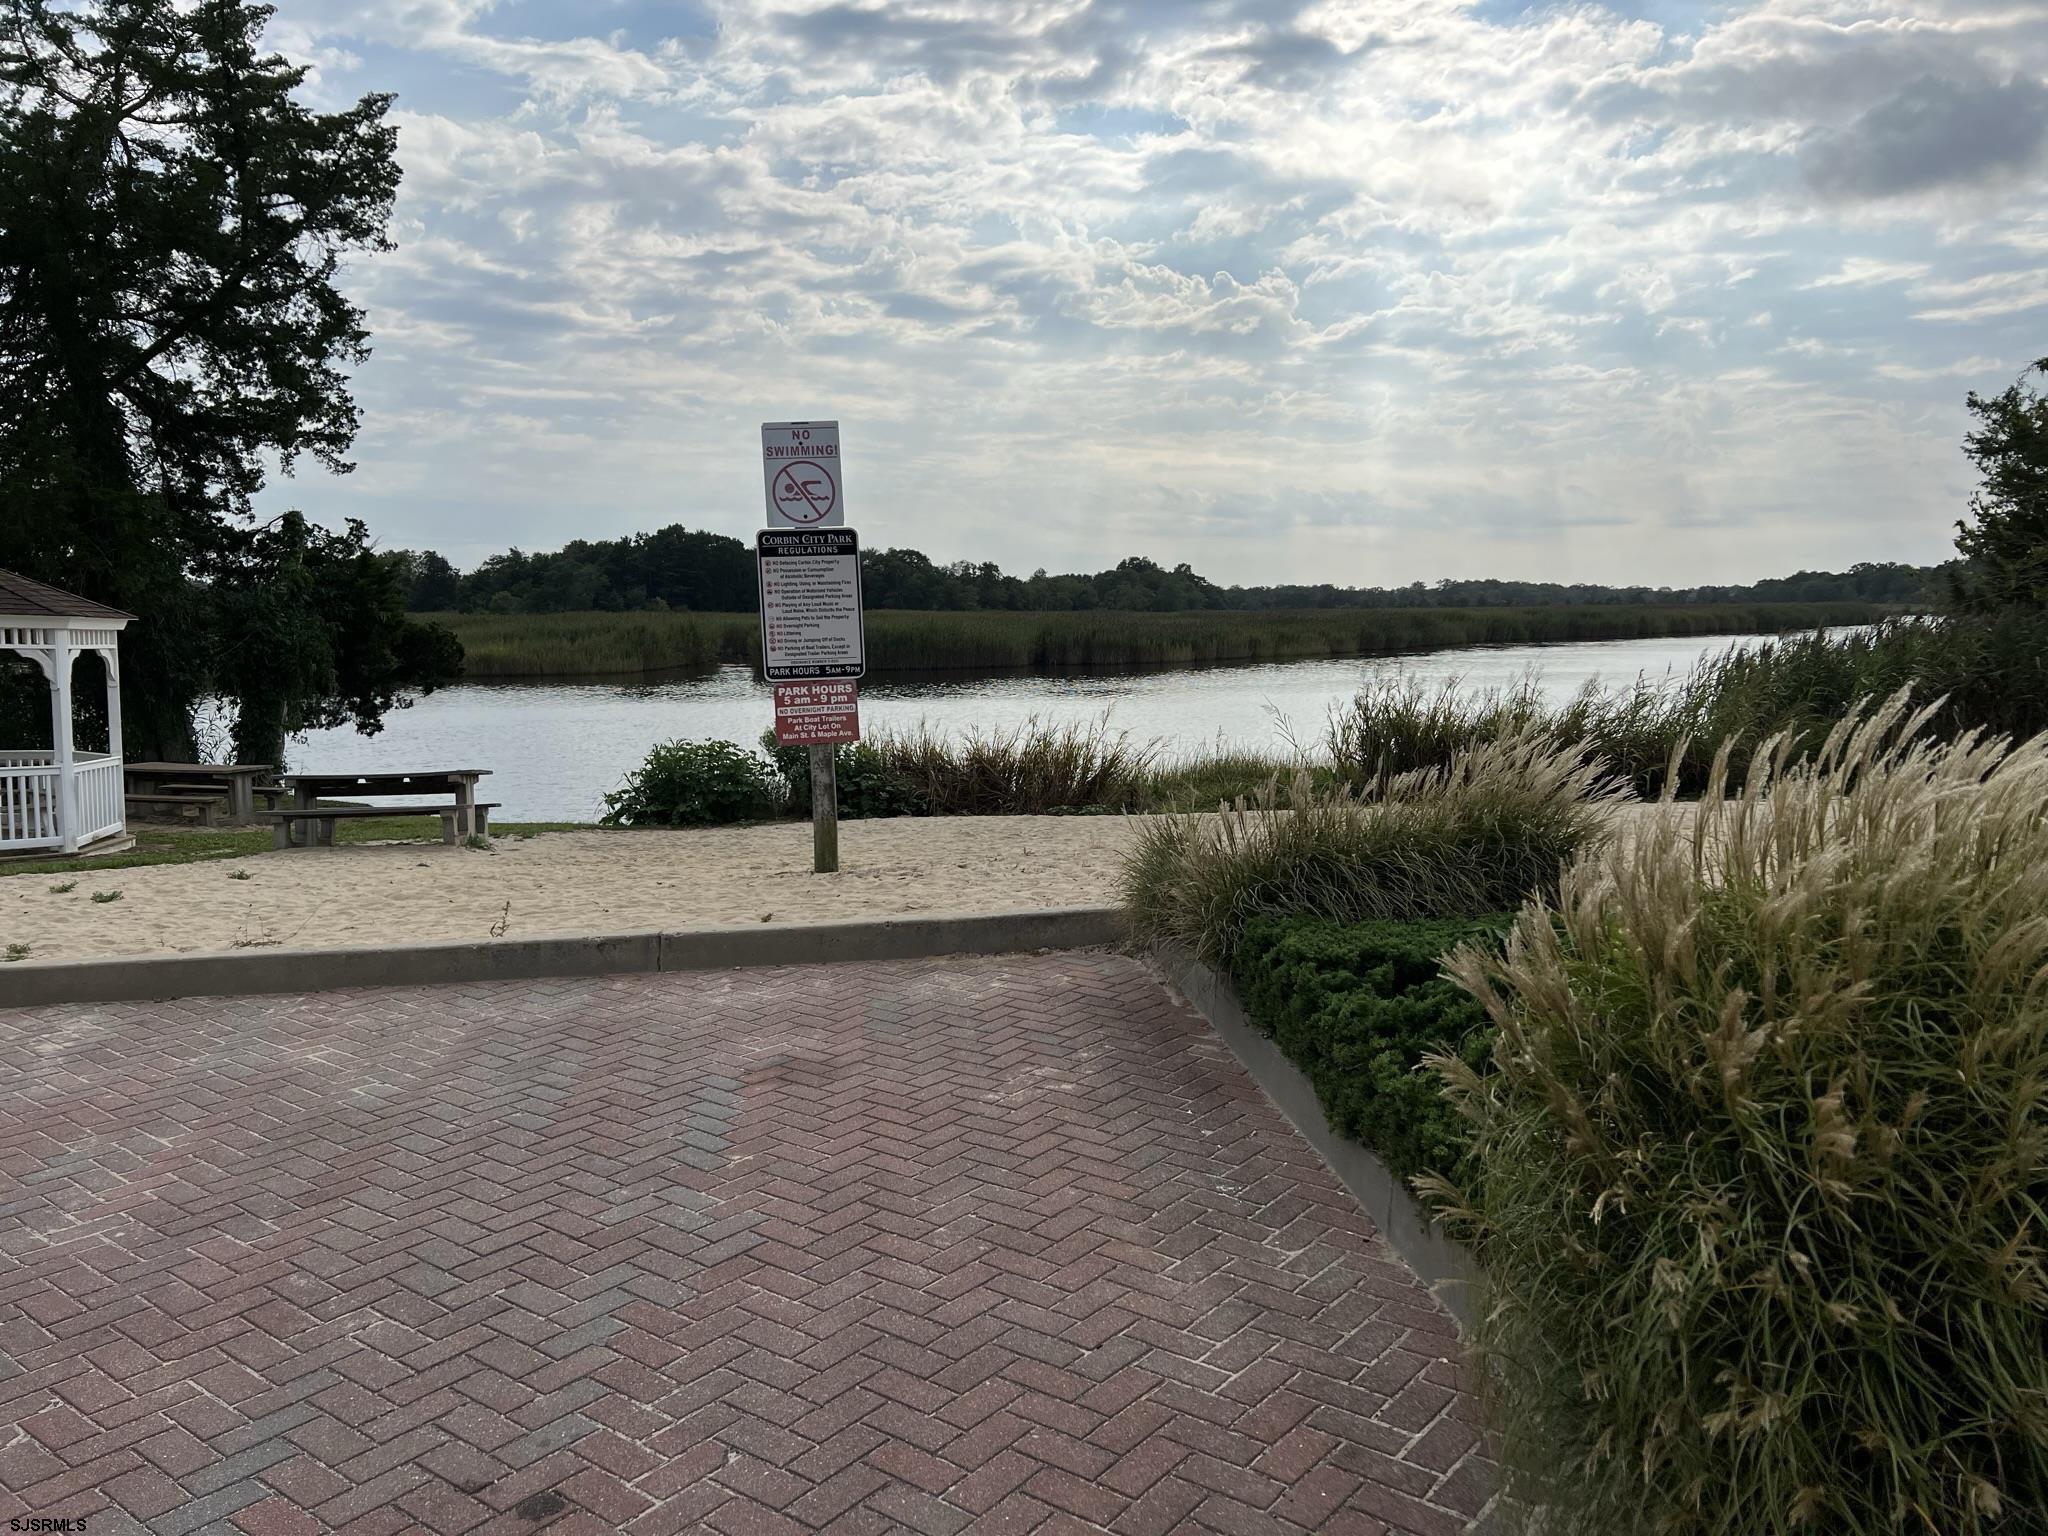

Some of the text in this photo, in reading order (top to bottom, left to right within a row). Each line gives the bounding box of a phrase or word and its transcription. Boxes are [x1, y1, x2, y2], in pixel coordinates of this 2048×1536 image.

[792, 430, 810, 440] NO
[766, 445, 838, 456] SWIMMING!
[762, 534, 852, 544] CORBIN CITY PARK
[778, 546, 838, 554] REGULATIONS
[769, 667, 791, 676] PARK
[792, 667, 820, 675] HOURS
[778, 684, 853, 696] PARK HOURS
[784, 697, 791, 705] 5
[820, 694, 827, 703] 9
[831, 695, 848, 704] pm
[790, 706, 825, 714] OVERNIGHT
